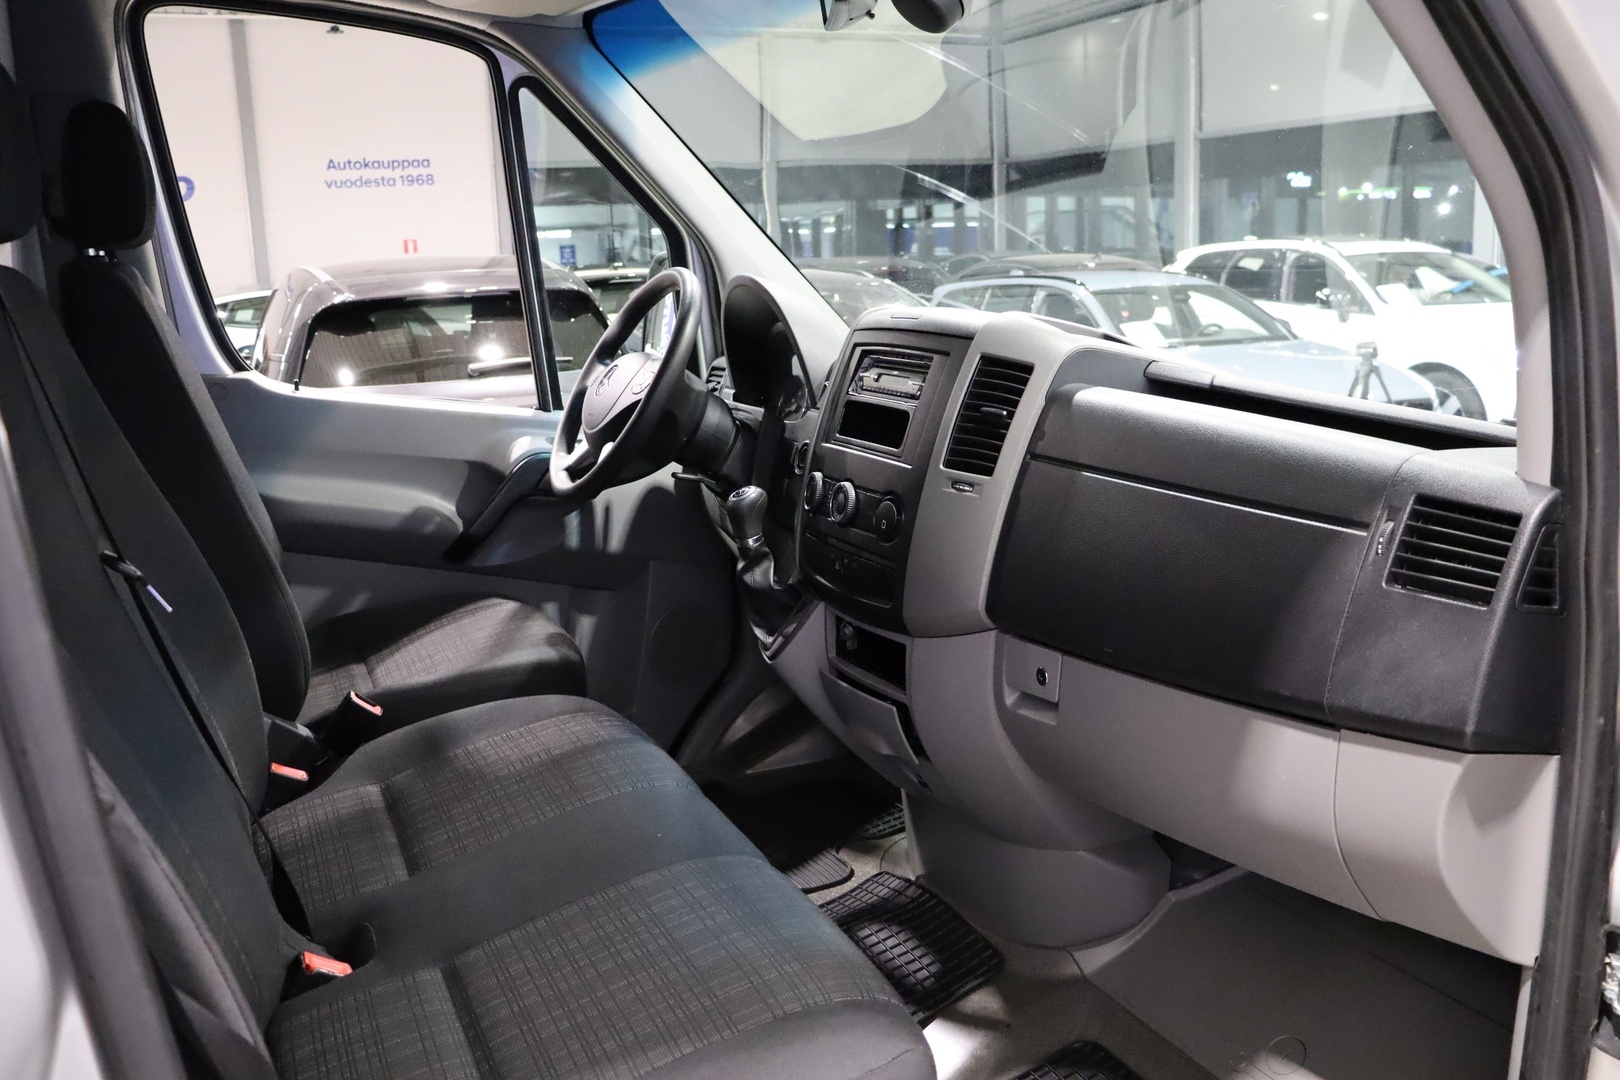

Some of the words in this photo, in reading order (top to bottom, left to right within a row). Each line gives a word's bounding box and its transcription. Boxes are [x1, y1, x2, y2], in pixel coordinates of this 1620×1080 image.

[326, 157, 431, 172] Autokauppaa
[324, 175, 397, 189] vuodesta
[399, 173, 435, 187] 1968
